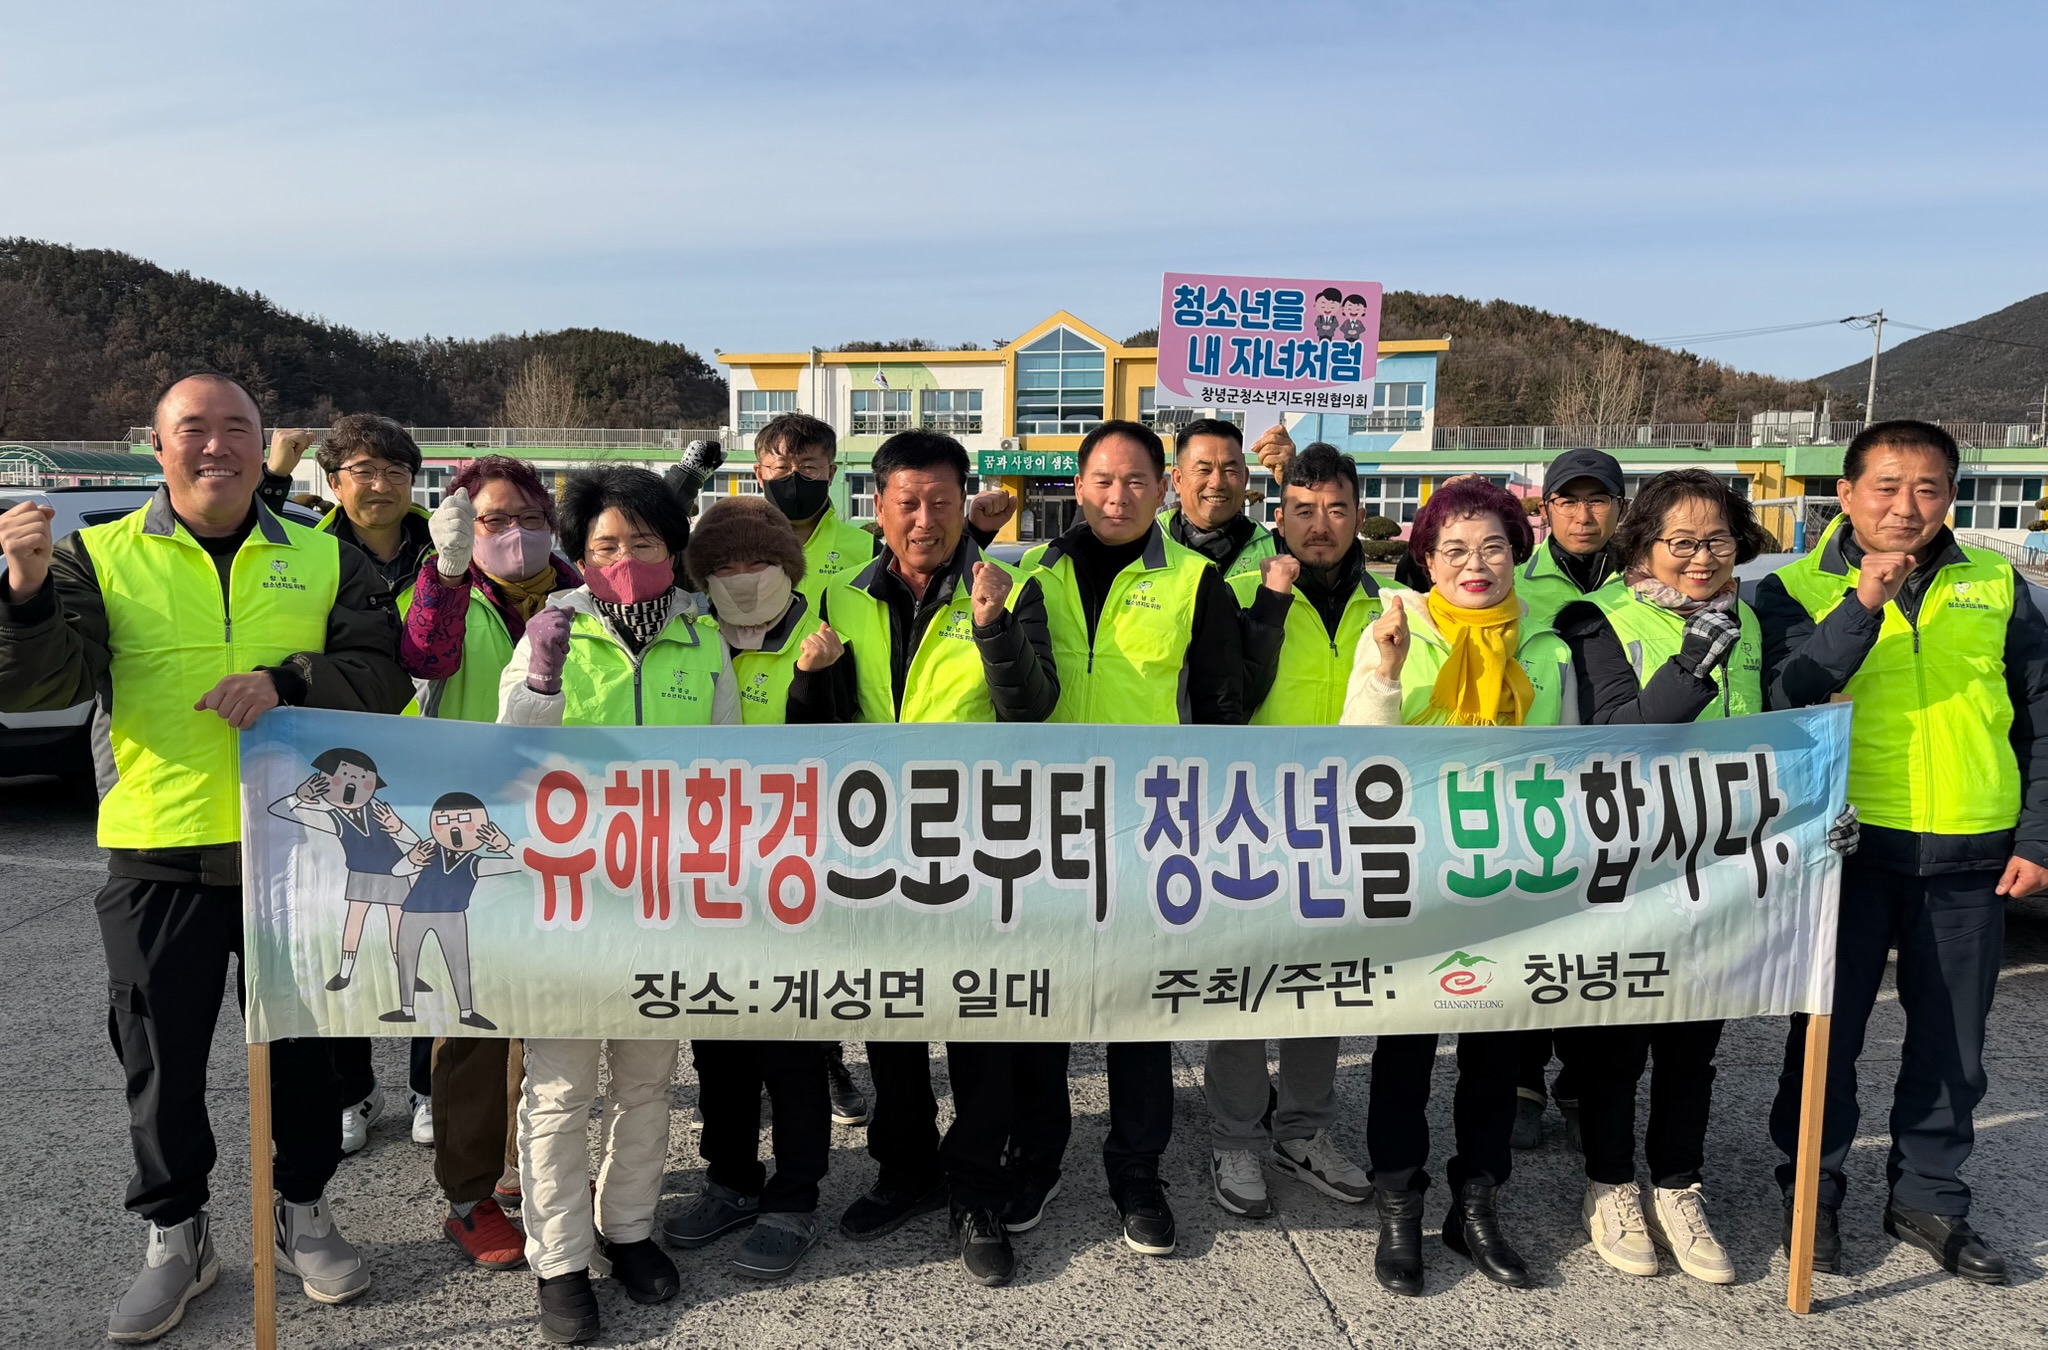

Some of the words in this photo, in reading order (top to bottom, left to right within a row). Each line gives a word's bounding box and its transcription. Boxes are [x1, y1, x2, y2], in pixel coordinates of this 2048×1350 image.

[1173, 284, 1305, 332] 청소년을
[1188, 334, 1221, 376] 내
[1229, 337, 1363, 383] 자녀처럼
[1201, 386, 1368, 409] 창녕군청소년지도위원협의회
[984, 455, 1008, 470] 꿈과
[1011, 455, 1046, 471] 사랑이
[522, 764, 1108, 926] 유해환경으로부터
[1142, 762, 1417, 926] 청소년을
[1445, 751, 1790, 904] 보호합시다.
[952, 967, 1051, 1019] 일대
[1522, 951, 1671, 1004] 창녕군
[1433, 1000, 1504, 1009] CHANGNYEONG
